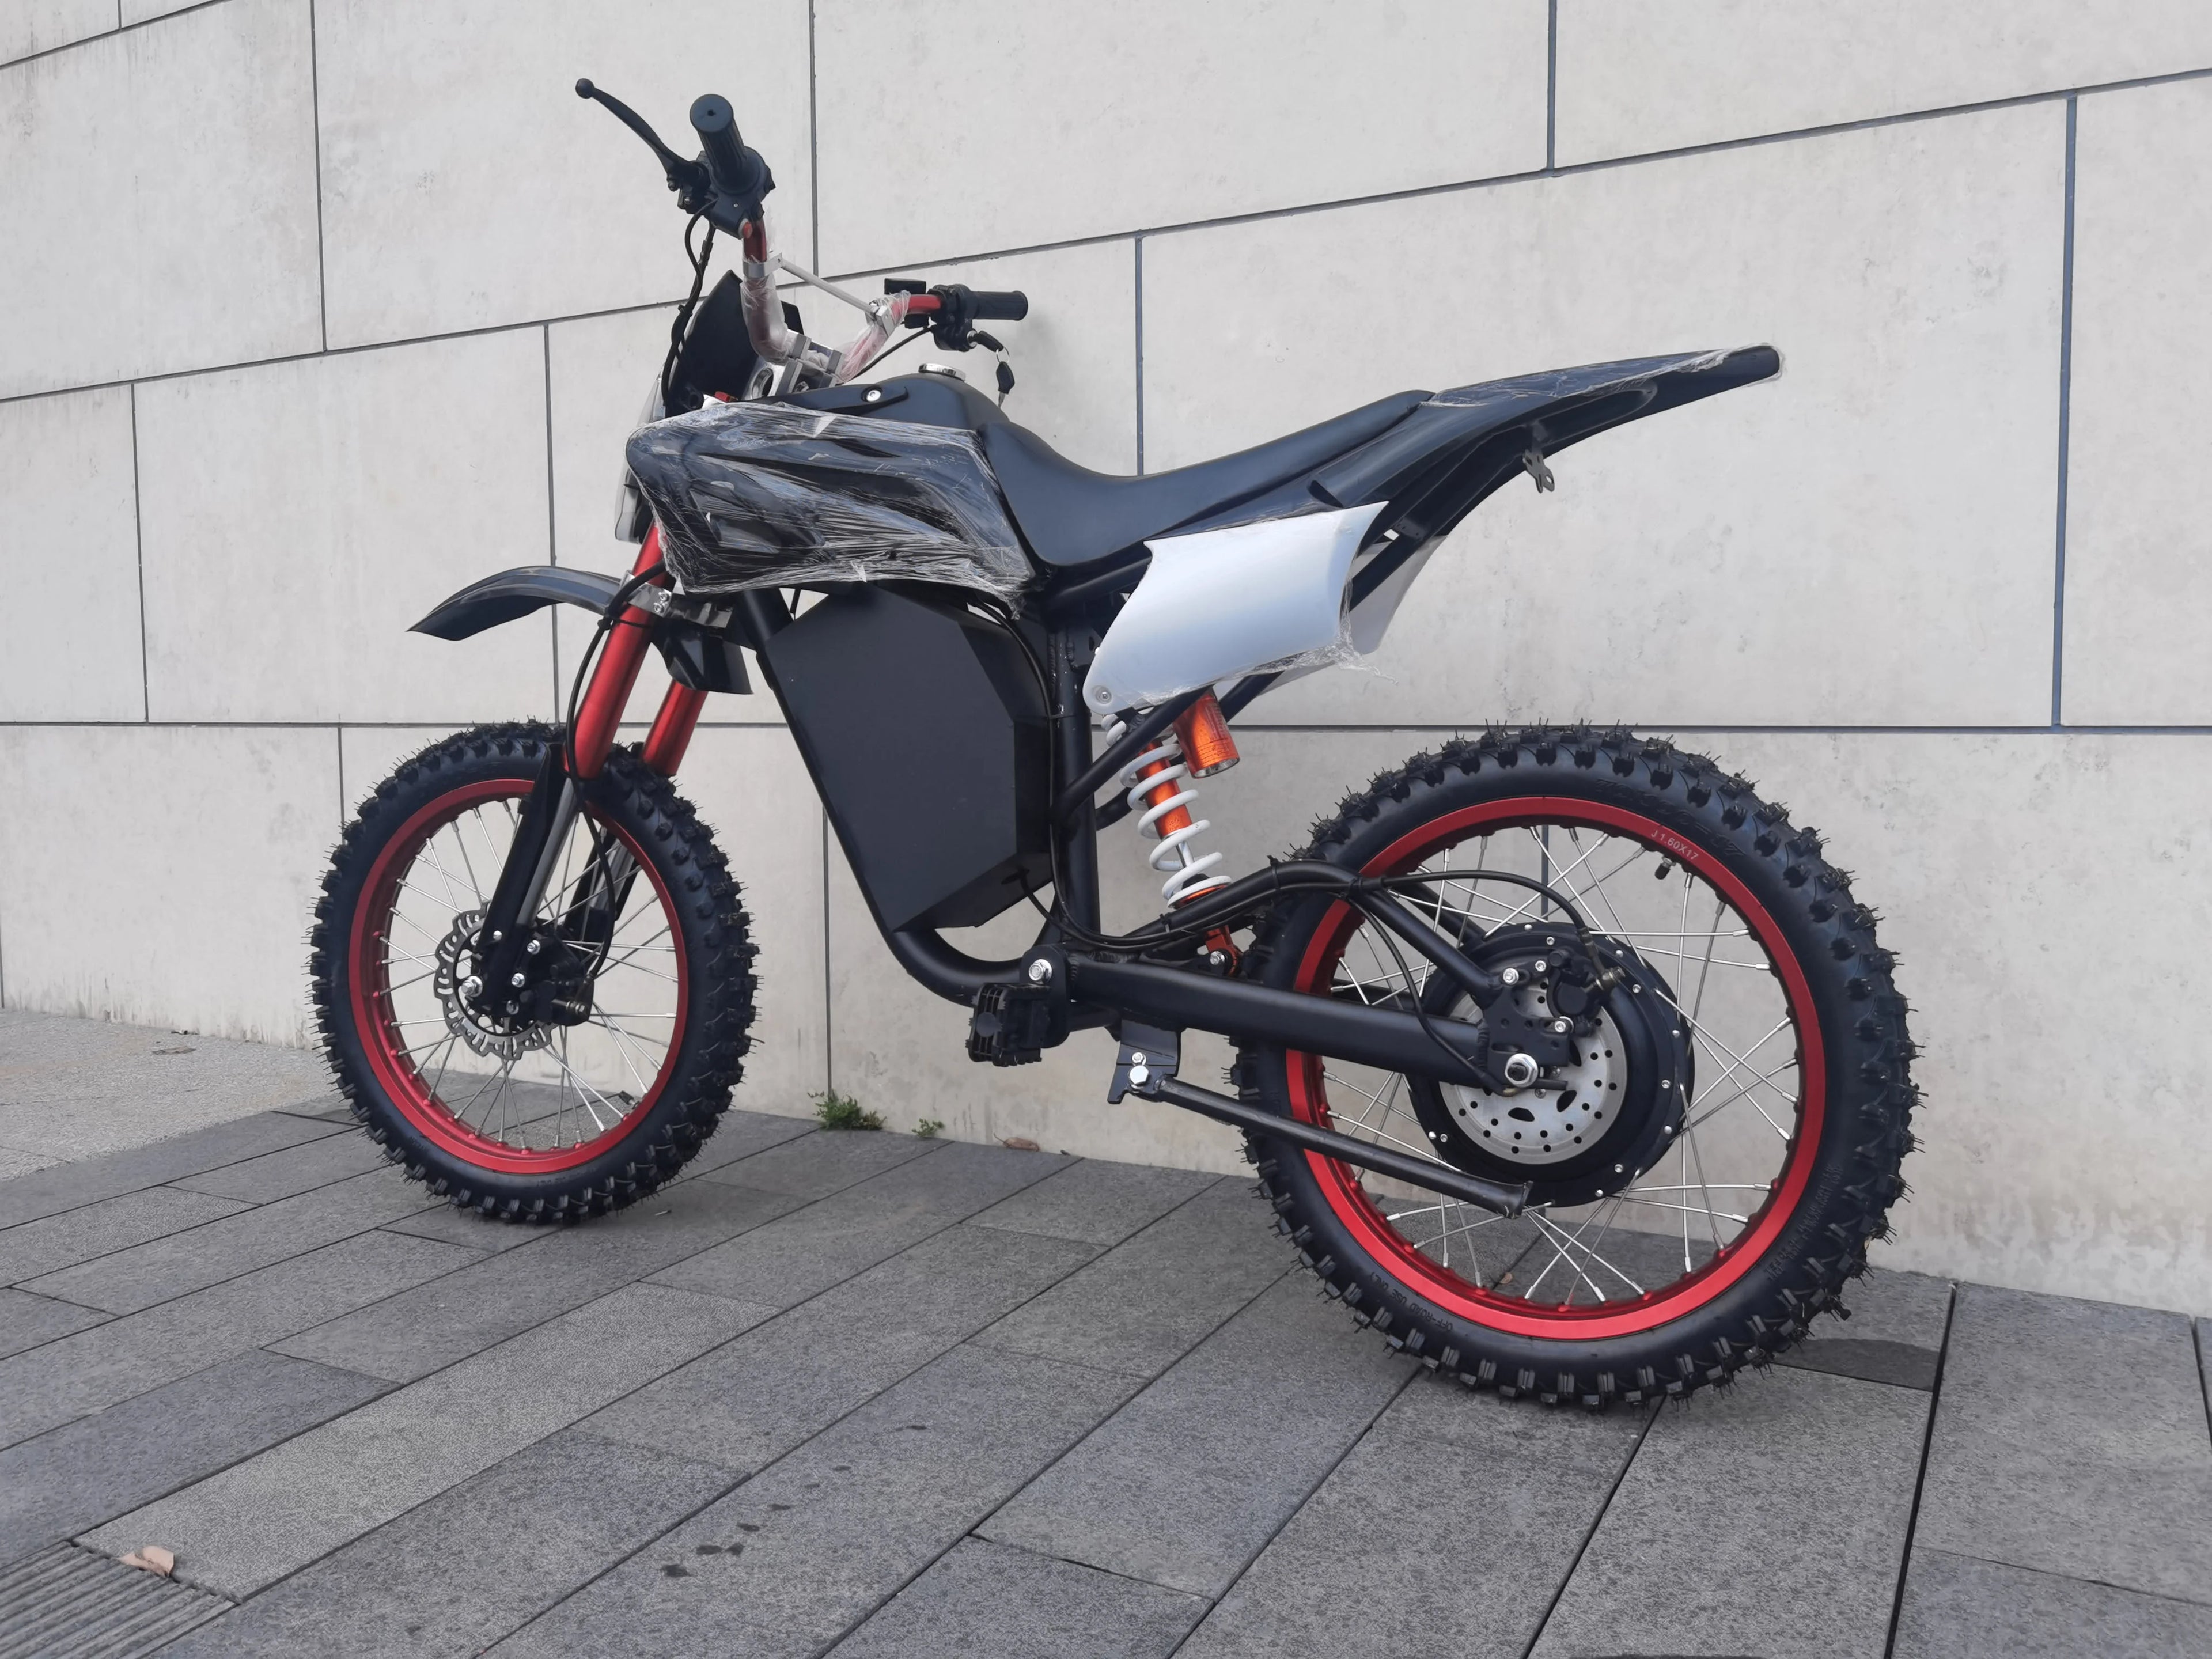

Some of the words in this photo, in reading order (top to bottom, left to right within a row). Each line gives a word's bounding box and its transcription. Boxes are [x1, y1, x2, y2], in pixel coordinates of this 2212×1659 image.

[1651, 830, 1658, 838] J
[1660, 833, 1699, 860] 1.60X17
[1370, 1272, 1389, 1290] ONLY
[1392, 1289, 1407, 1304] USE
[1410, 1302, 1453, 1331] OFF-ROAD
